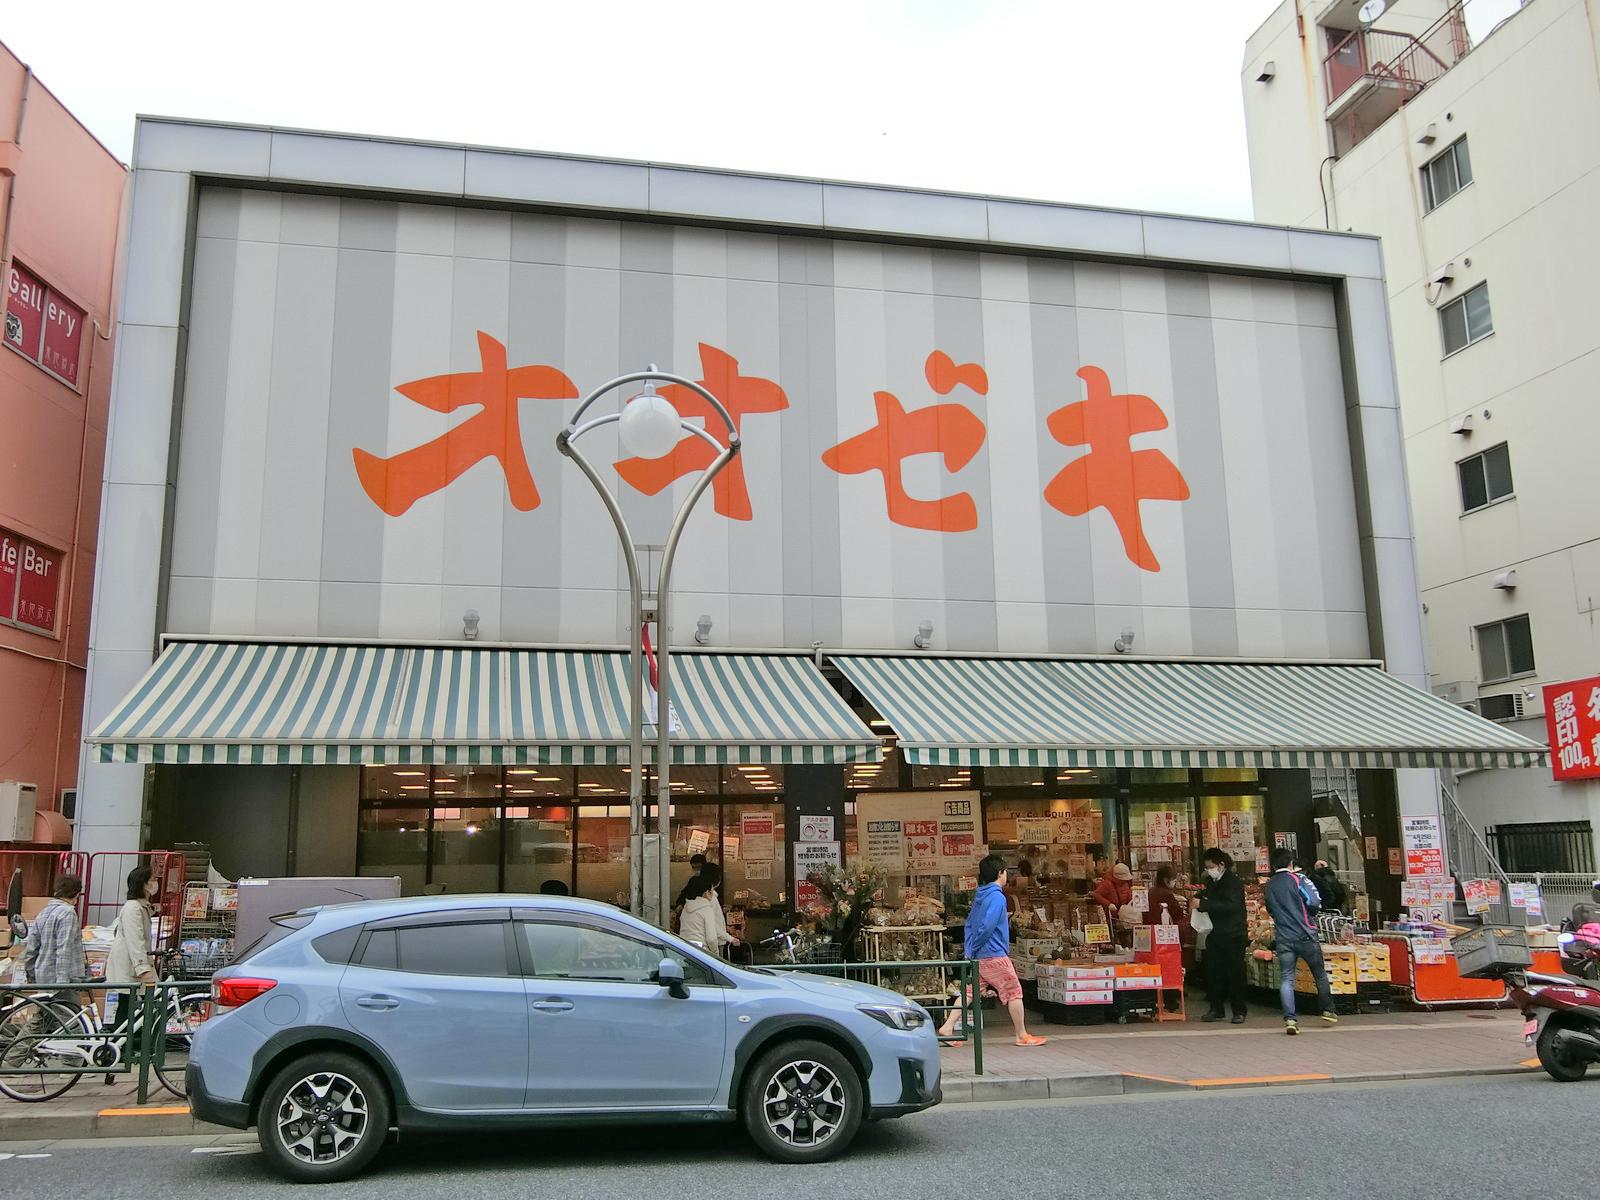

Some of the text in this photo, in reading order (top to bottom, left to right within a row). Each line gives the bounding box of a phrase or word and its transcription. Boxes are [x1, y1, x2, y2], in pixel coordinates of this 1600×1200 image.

[9, 268, 76, 338] Gallery
[353, 330, 1190, 572] オオゼキ
[0, 538, 52, 577] fe Bar
